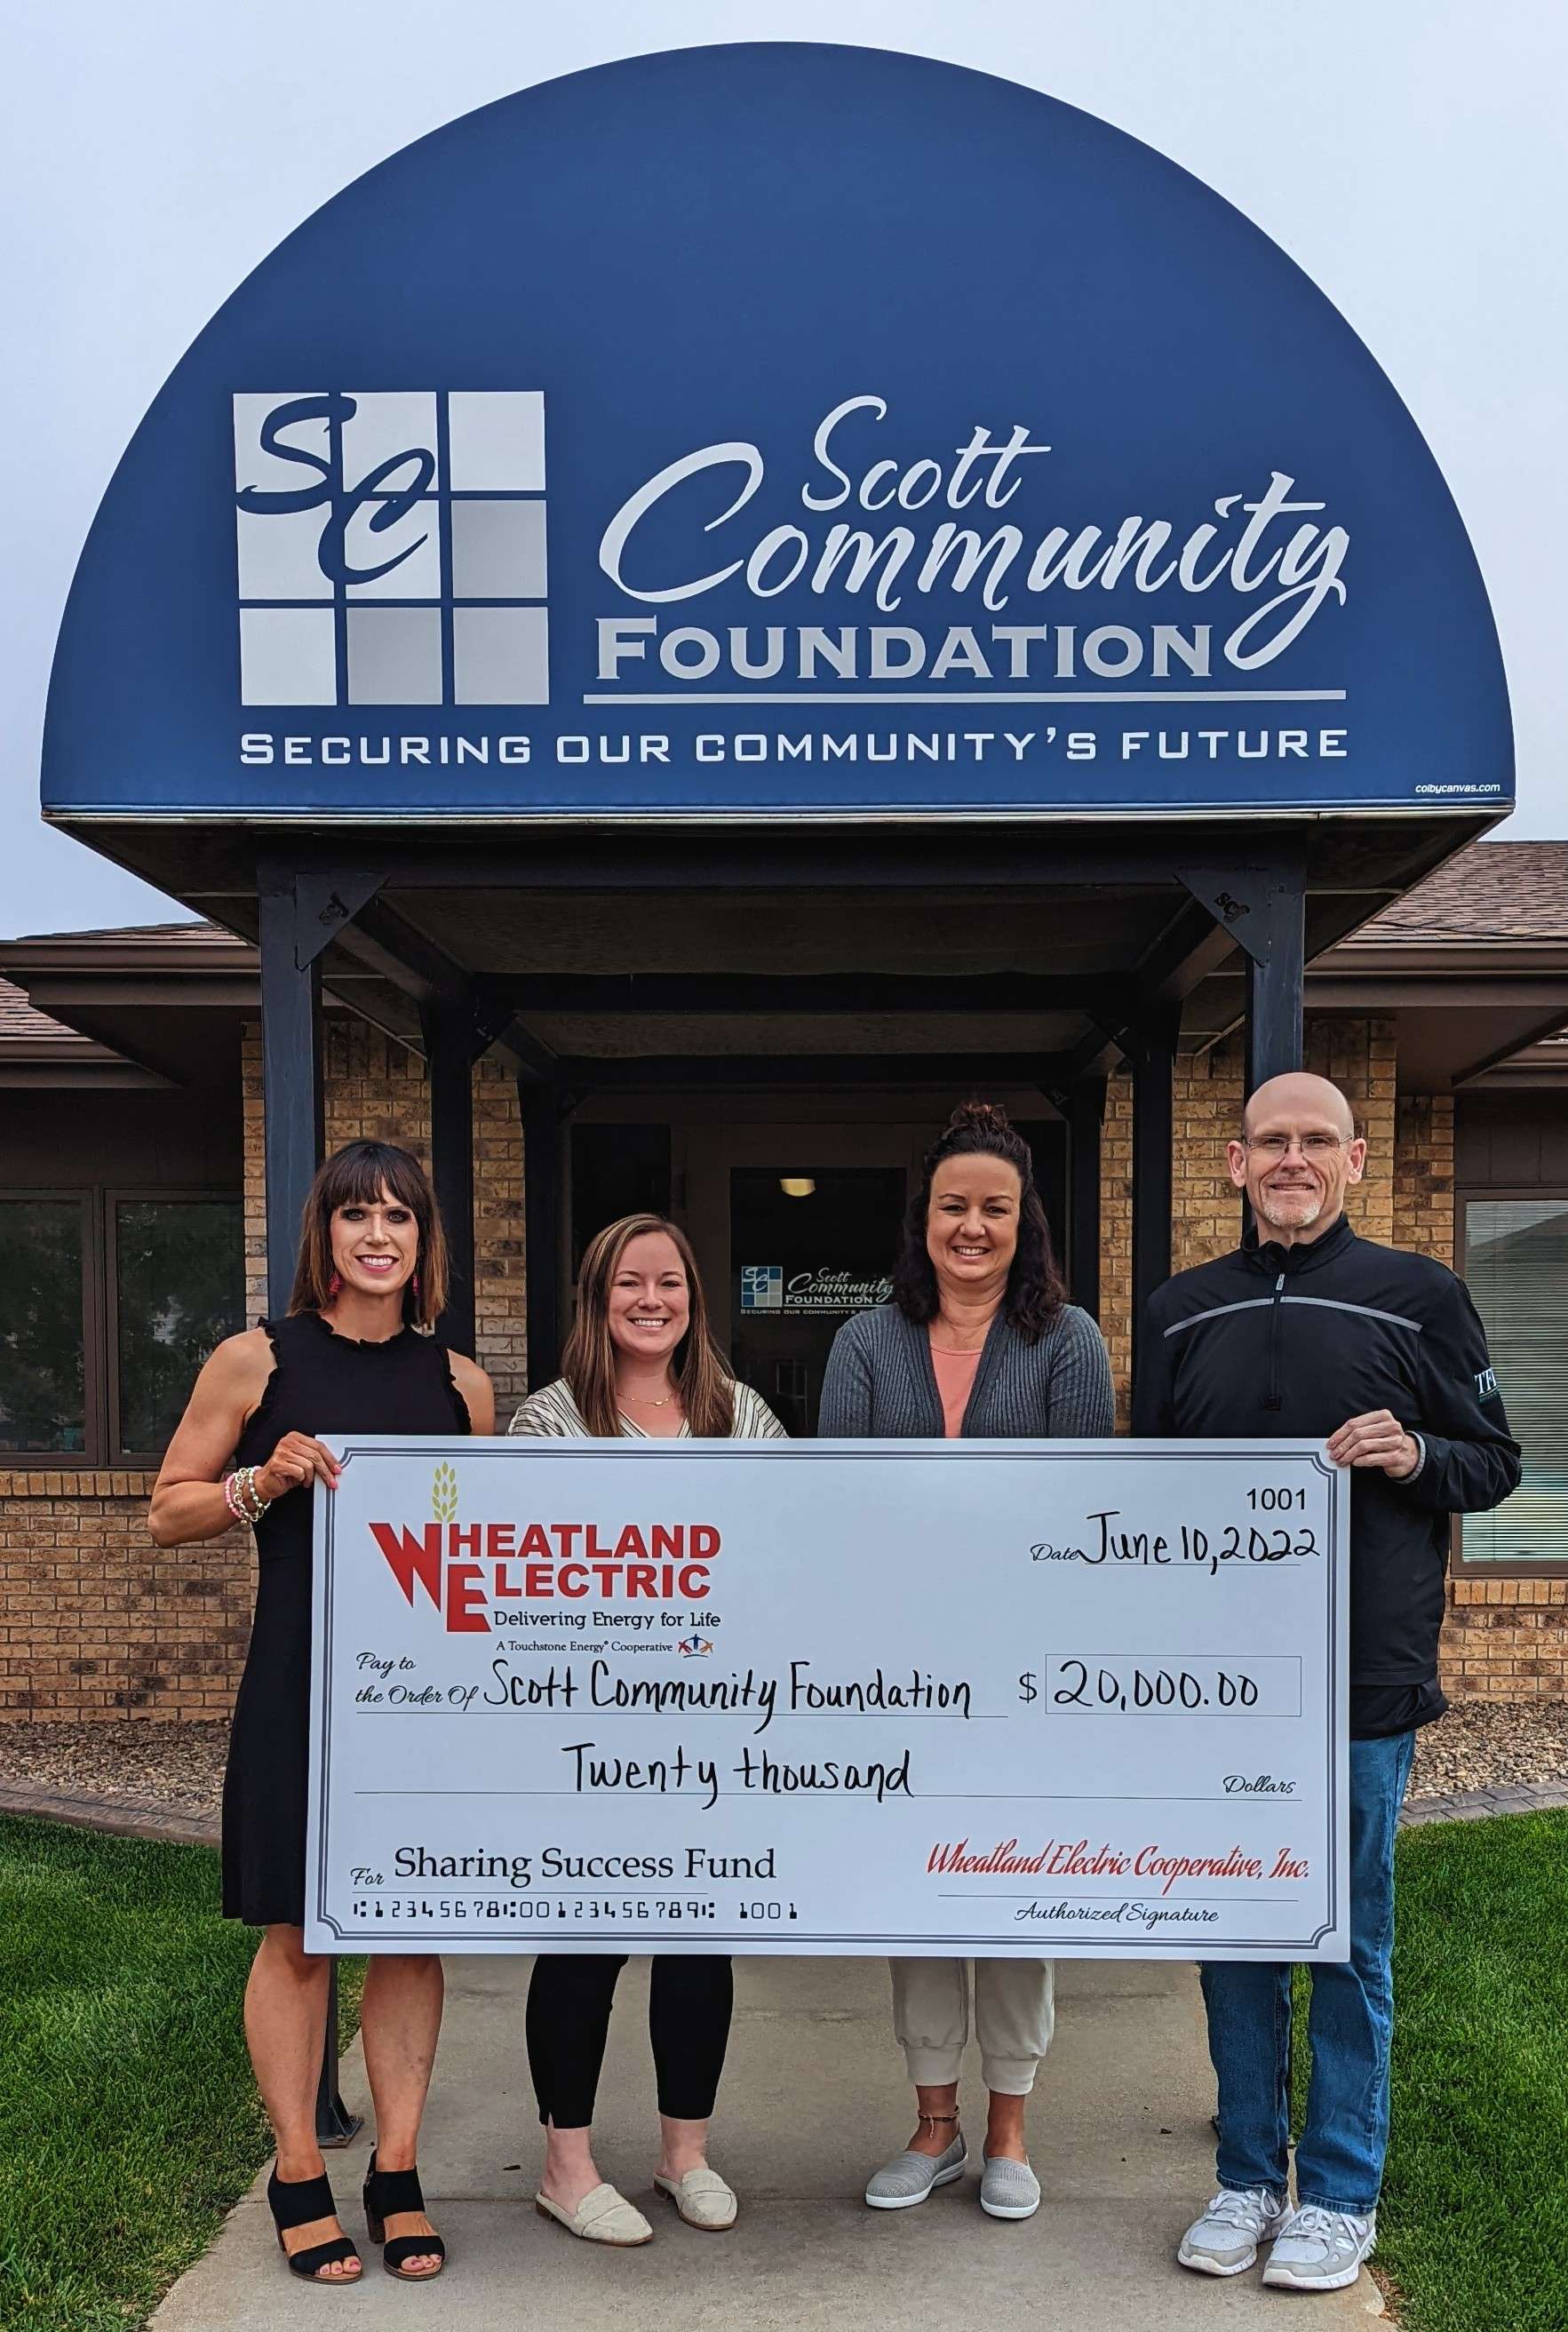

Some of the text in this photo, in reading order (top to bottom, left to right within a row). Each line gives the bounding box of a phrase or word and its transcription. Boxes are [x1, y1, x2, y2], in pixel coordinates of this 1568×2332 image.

[801, 395, 1052, 512] Scott
[599, 442, 1350, 671] Community
[595, 614, 1213, 680] FOUNDATION
[241, 726, 1349, 764] SECURING OUR COMMUNITY'S FUTURE
[1414, 784, 1500, 794] colbycanvas.com
[787, 1272, 895, 1303] Community
[816, 1267, 852, 1283] Scott
[785, 1294, 874, 1304] FOUNDATION
[1246, 1488, 1306, 1510] 1001
[1030, 1542, 1079, 1562] Date
[1076, 1510, 1172, 1565] June
[368, 1522, 721, 1612] WHEATLAND
[447, 1564, 712, 1632] ELECTRIC
[494, 1611, 721, 1629] Delivering Energy for Life
[496, 1641, 506, 1651] A
[508, 1641, 567, 1652] Touchstone
[611, 1641, 673, 1654] Cooperative
[356, 1652, 417, 1679] Pay to
[354, 1683, 480, 1711] the Order Of
[483, 1659, 971, 1734] Scott Community Foundation
[1019, 1671, 1038, 1703] $
[1054, 1660, 1259, 1711] 20,000.00
[561, 1742, 916, 1810] Twenty thousand
[1222, 1775, 1296, 1795] Dollars
[351, 1848, 777, 1888] For Sharing Success Fund
[927, 1838, 1310, 1895] Wheatland Electric Cooperative, Inc.
[739, 1901, 799, 1920] 1001
[1014, 1901, 1220, 1930] Authorized Signature
